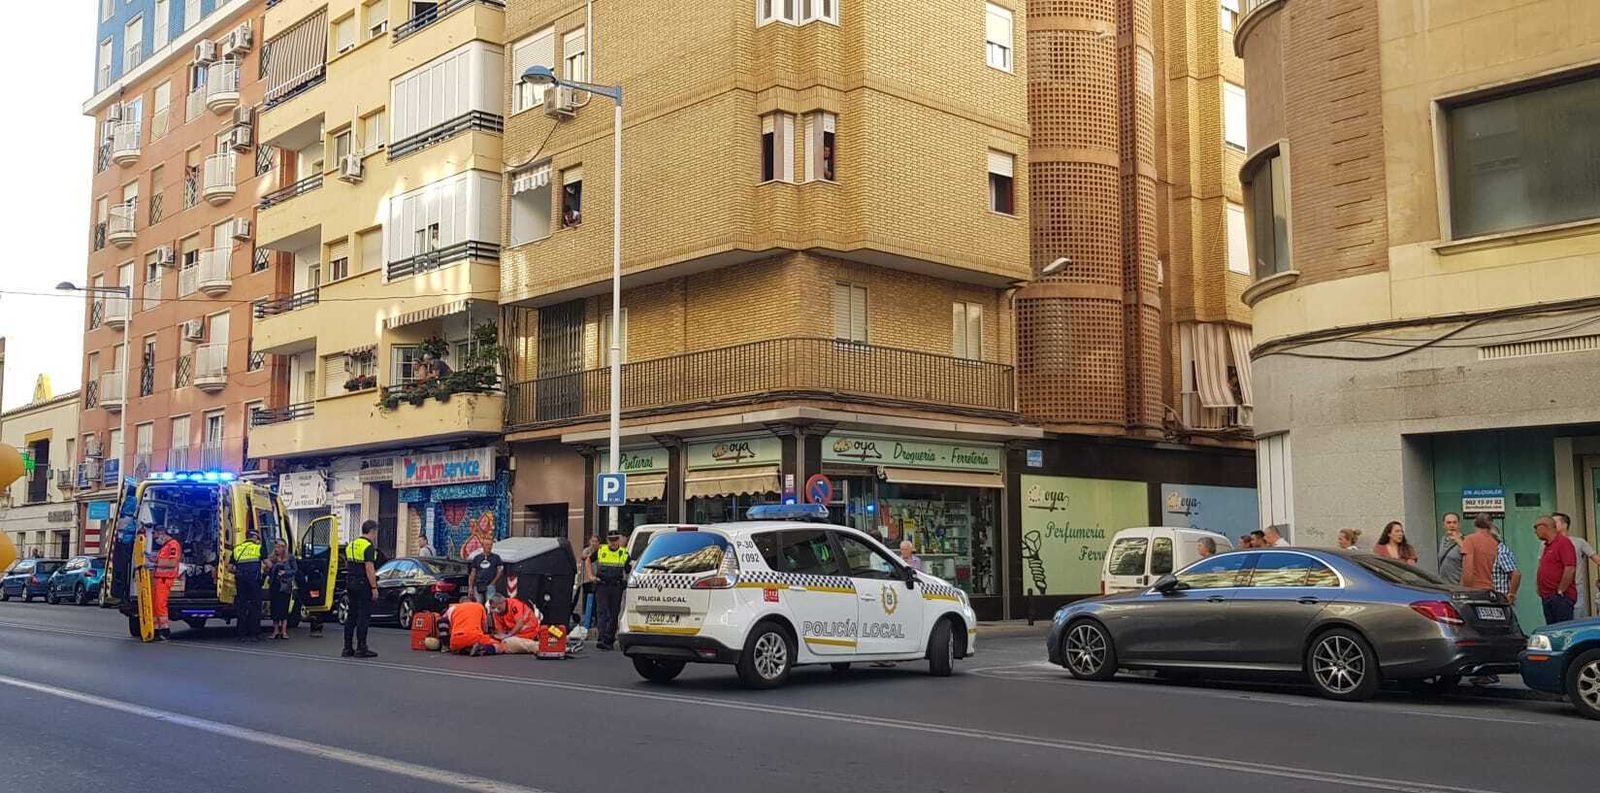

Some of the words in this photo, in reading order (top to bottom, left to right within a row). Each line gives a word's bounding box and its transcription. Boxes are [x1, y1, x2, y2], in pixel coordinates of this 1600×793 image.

[619, 453, 653, 470] Pinturas
[603, 477, 620, 502] P
[736, 541, 754, 549] P-30
[745, 553, 760, 563] 092
[862, 622, 905, 639] LOCAL
